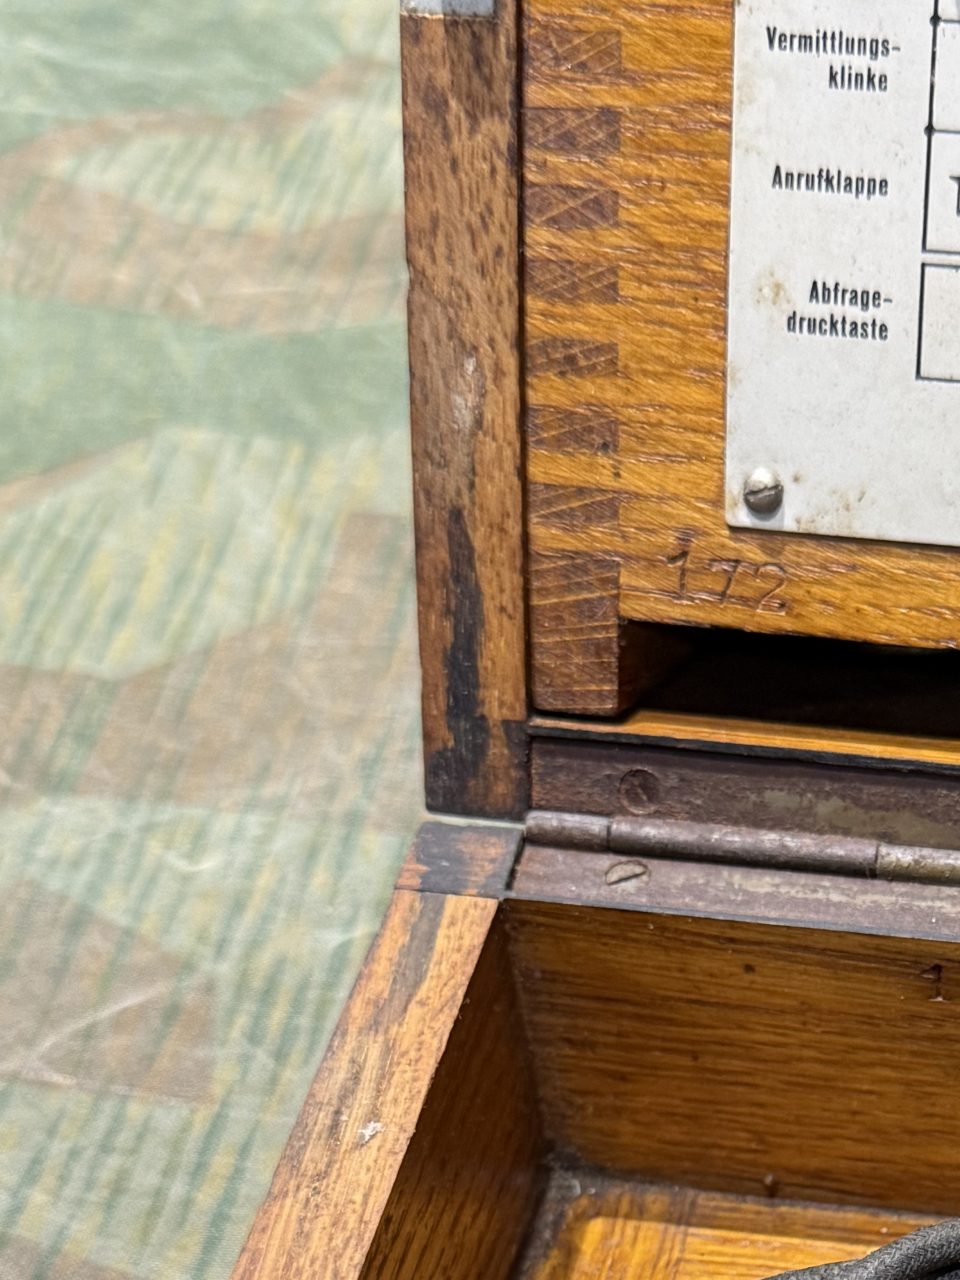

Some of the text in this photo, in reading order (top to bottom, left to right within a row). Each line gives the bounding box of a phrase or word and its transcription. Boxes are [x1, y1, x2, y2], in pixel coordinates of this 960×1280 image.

[766, 26, 901, 61] Vermittlungs-
[828, 64, 888, 92] klinke
[772, 164, 889, 200] Anrufklappe
[809, 280, 893, 312] Abfrage-
[787, 310, 889, 341] drucktaste
[666, 549, 788, 615] 172
